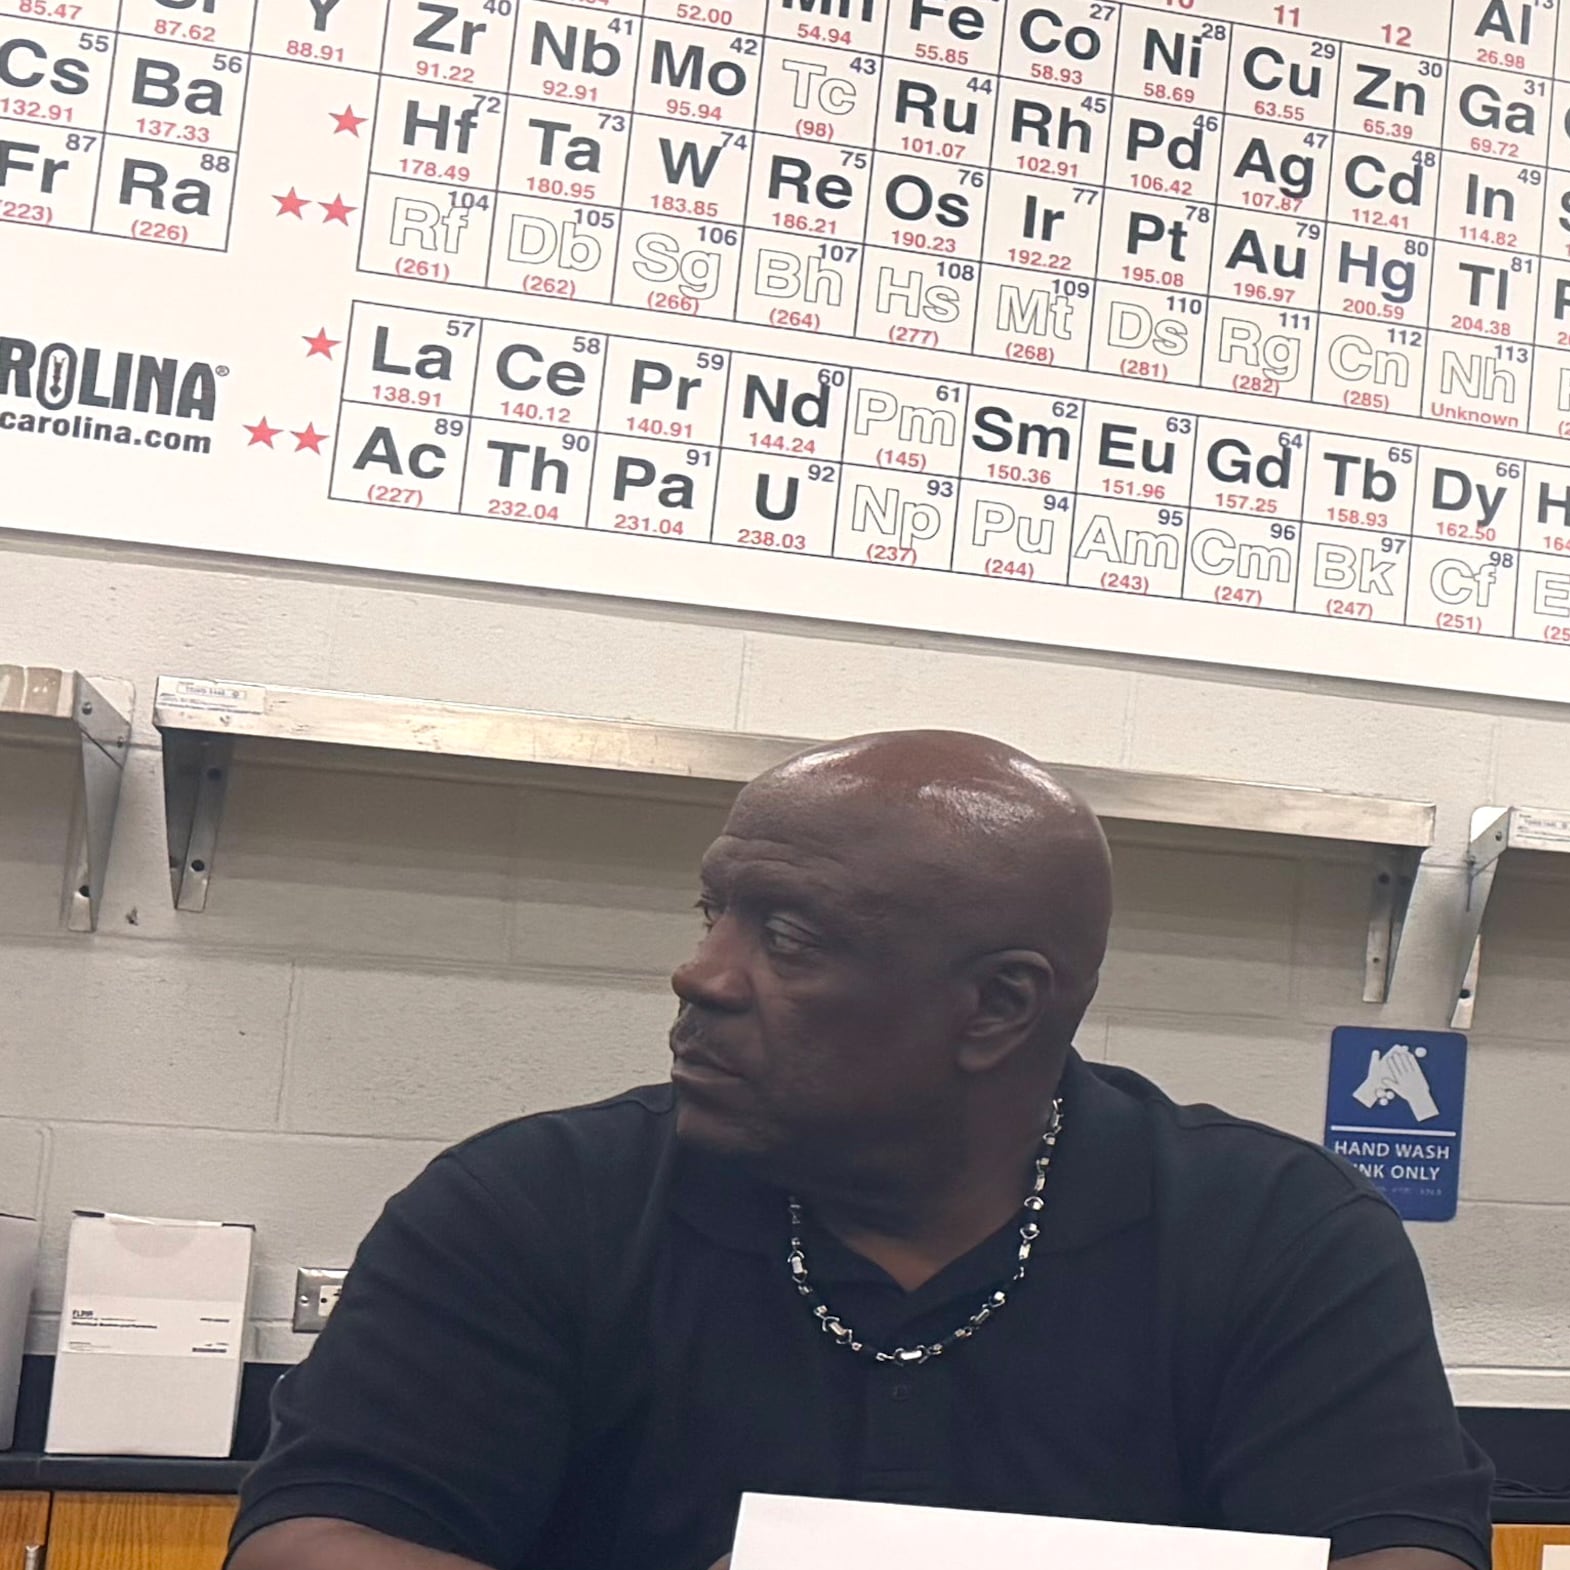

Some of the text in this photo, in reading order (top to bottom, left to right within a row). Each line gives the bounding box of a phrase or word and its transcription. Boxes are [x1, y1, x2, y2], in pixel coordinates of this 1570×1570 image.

[79, 33, 109, 52] 55
[531, 21, 620, 76] Nb
[608, 18, 633, 35] 41
[1020, 9, 1100, 60] Co
[1311, 42, 1335, 59] 29
[1382, 24, 1412, 47] 12
[0, 39, 89, 95] Cs
[213, 54, 242, 73] 56
[651, 40, 746, 96] Mo
[850, 57, 876, 75] 43
[1030, 65, 1083, 84] 58.93
[1143, 28, 1201, 78] Ni
[1243, 47, 1321, 98] Cu
[1418, 61, 1442, 78] 30
[132, 58, 222, 116] Ba
[782, 59, 856, 115] Tc
[1143, 84, 1195, 103] 58.69
[1353, 64, 1425, 116] Zn
[1459, 84, 1534, 135] Ga
[137, 118, 210, 143] 137.33
[529, 118, 600, 173] Ta
[795, 120, 834, 141] (98)
[200, 154, 230, 173] 88
[768, 155, 852, 209] Re
[840, 150, 866, 169] 75
[1233, 138, 1314, 200] Ag
[119, 158, 210, 216] Ra
[527, 177, 595, 199] 180.95
[886, 175, 969, 227] Os
[1131, 175, 1192, 196] 106.42
[1466, 173, 1514, 221] In
[130, 221, 189, 247] (226)
[773, 212, 836, 235] 186.21
[1023, 195, 1064, 241] Ir
[1127, 211, 1188, 262] Pt
[1123, 266, 1184, 288] 195.08
[1225, 229, 1306, 279] Au
[1339, 241, 1415, 303] Hg
[1234, 282, 1295, 303] 196.97
[446, 320, 475, 337] 57
[372, 326, 452, 381] La
[496, 344, 585, 396] Ce
[0, 411, 211, 454] carolina.com
[854, 388, 956, 446] Pm
[972, 406, 1070, 460] Sm
[1166, 417, 1191, 434] 63
[353, 426, 446, 479] Ac
[487, 440, 568, 494] Th
[1099, 423, 1175, 474] Eu
[366, 485, 423, 504] (227)
[613, 456, 693, 509] Pa
[756, 473, 799, 521] U
[808, 464, 835, 482] 92
[988, 464, 1050, 485] 150.36
[487, 499, 559, 520] 232.04
[1432, 467, 1507, 528] Dy
[972, 500, 1054, 555] Pu
[984, 559, 1035, 578] (244)
[1191, 528, 1291, 583] Cm
[1334, 1141, 1450, 1159] HAND WASH
[1391, 1165, 1440, 1180] ONLY
